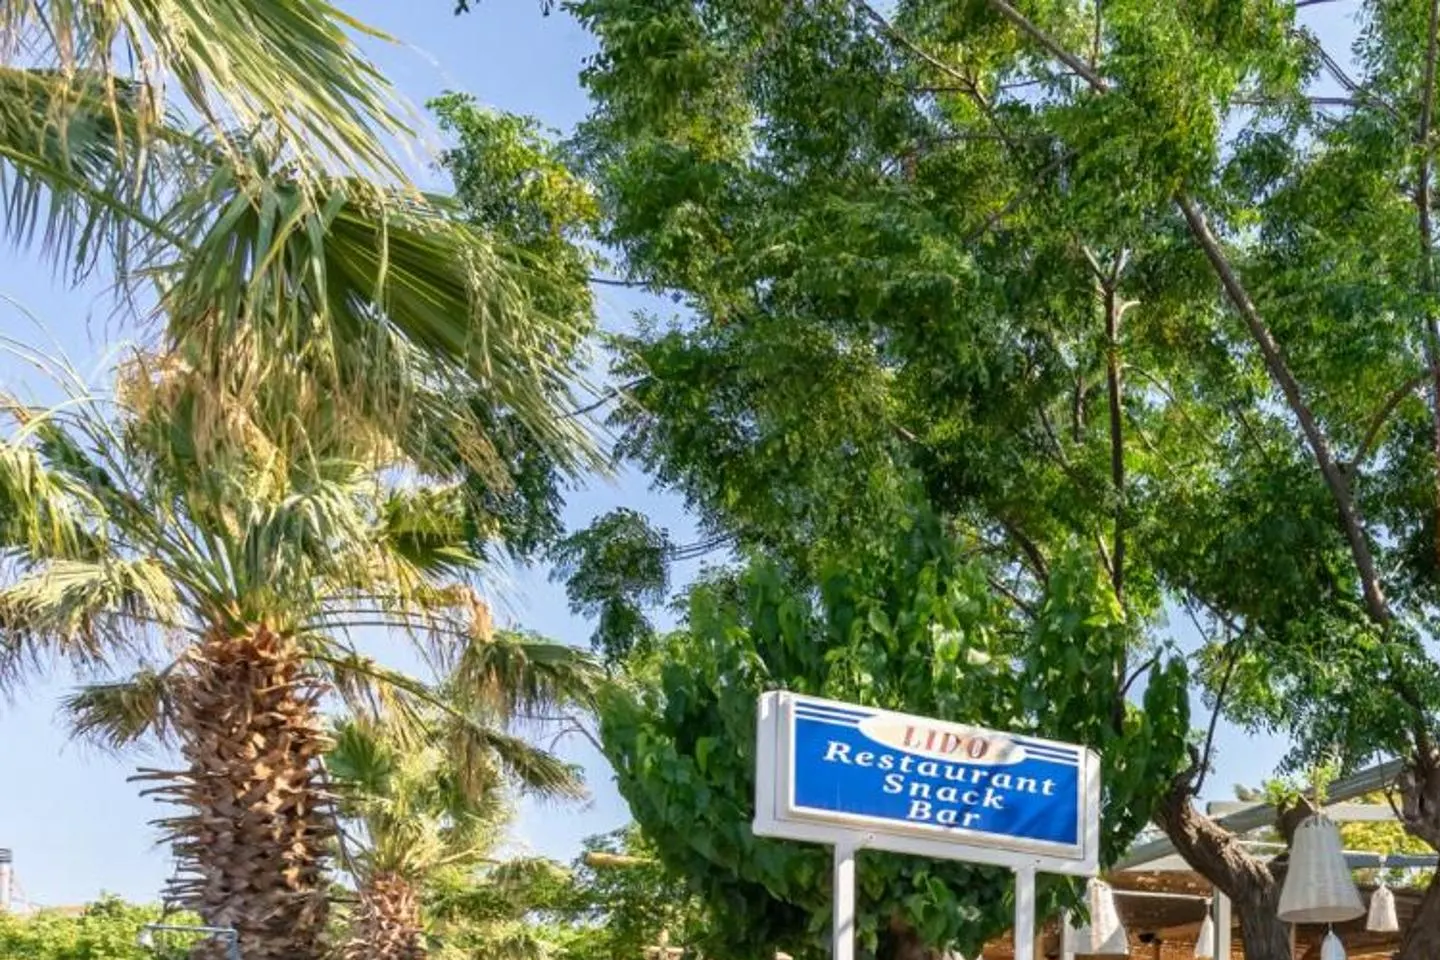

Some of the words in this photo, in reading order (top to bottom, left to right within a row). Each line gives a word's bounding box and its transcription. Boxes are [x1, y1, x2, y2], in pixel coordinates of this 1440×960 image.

[903, 726, 988, 759] LIDO
[824, 740, 1056, 796] Restaurant
[883, 774, 1004, 809] Snack
[906, 800, 981, 827] Bar
